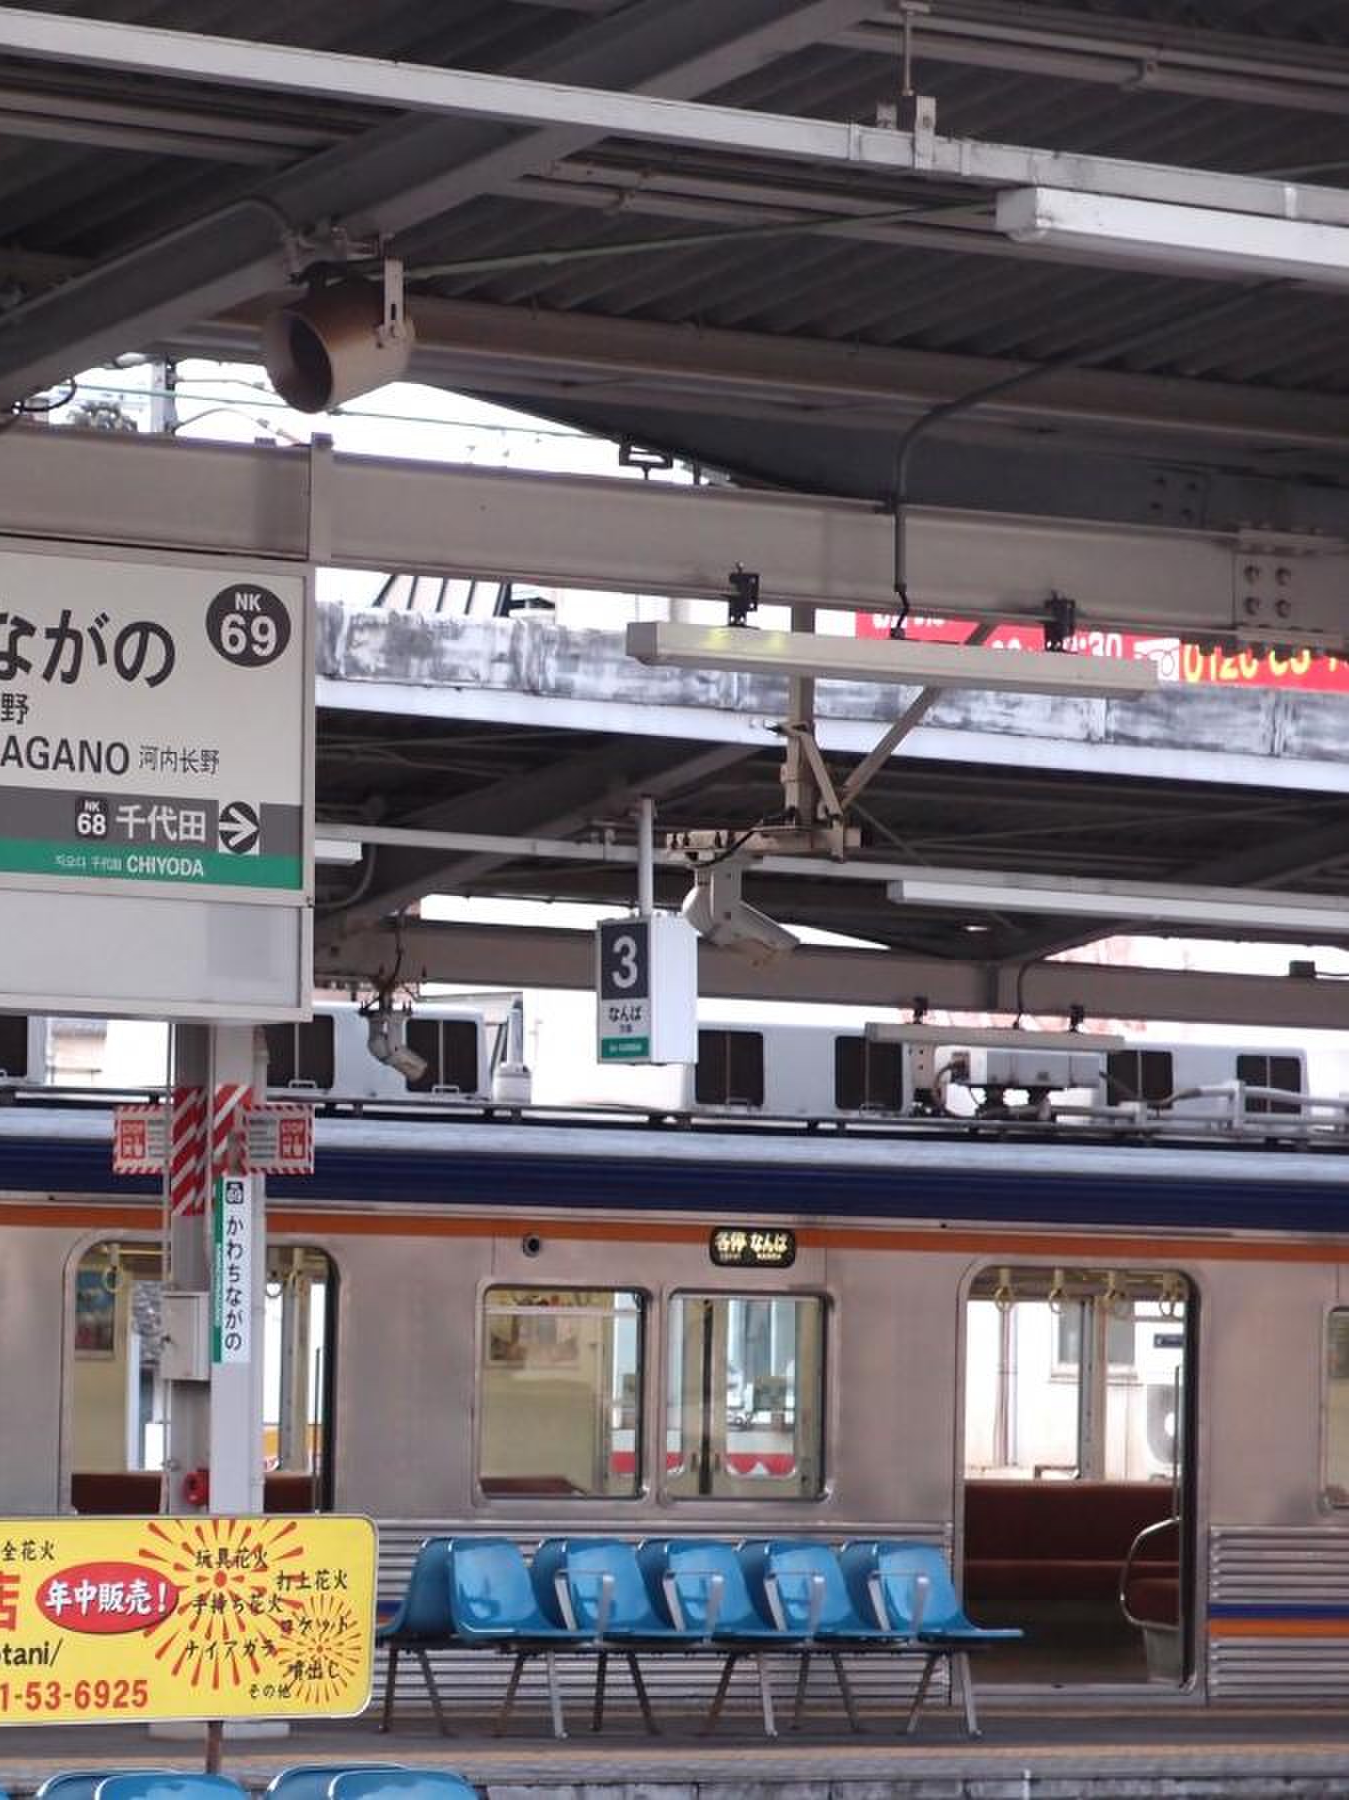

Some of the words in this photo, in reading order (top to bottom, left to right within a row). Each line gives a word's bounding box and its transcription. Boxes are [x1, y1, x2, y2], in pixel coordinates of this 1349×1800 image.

[234, 591, 262, 612] NK
[219, 613, 278, 657] 69
[138, 744, 220, 775] 河内长野
[84, 801, 101, 813] NK
[76, 814, 107, 836] 68
[115, 804, 207, 842] 千代田
[126, 854, 205, 877] CHIYODA
[611, 935, 639, 989] 3
[608, 1006, 642, 1022] なんば
[224, 1215, 245, 1351] かわちながの
[248, 1683, 292, 1700] その他
